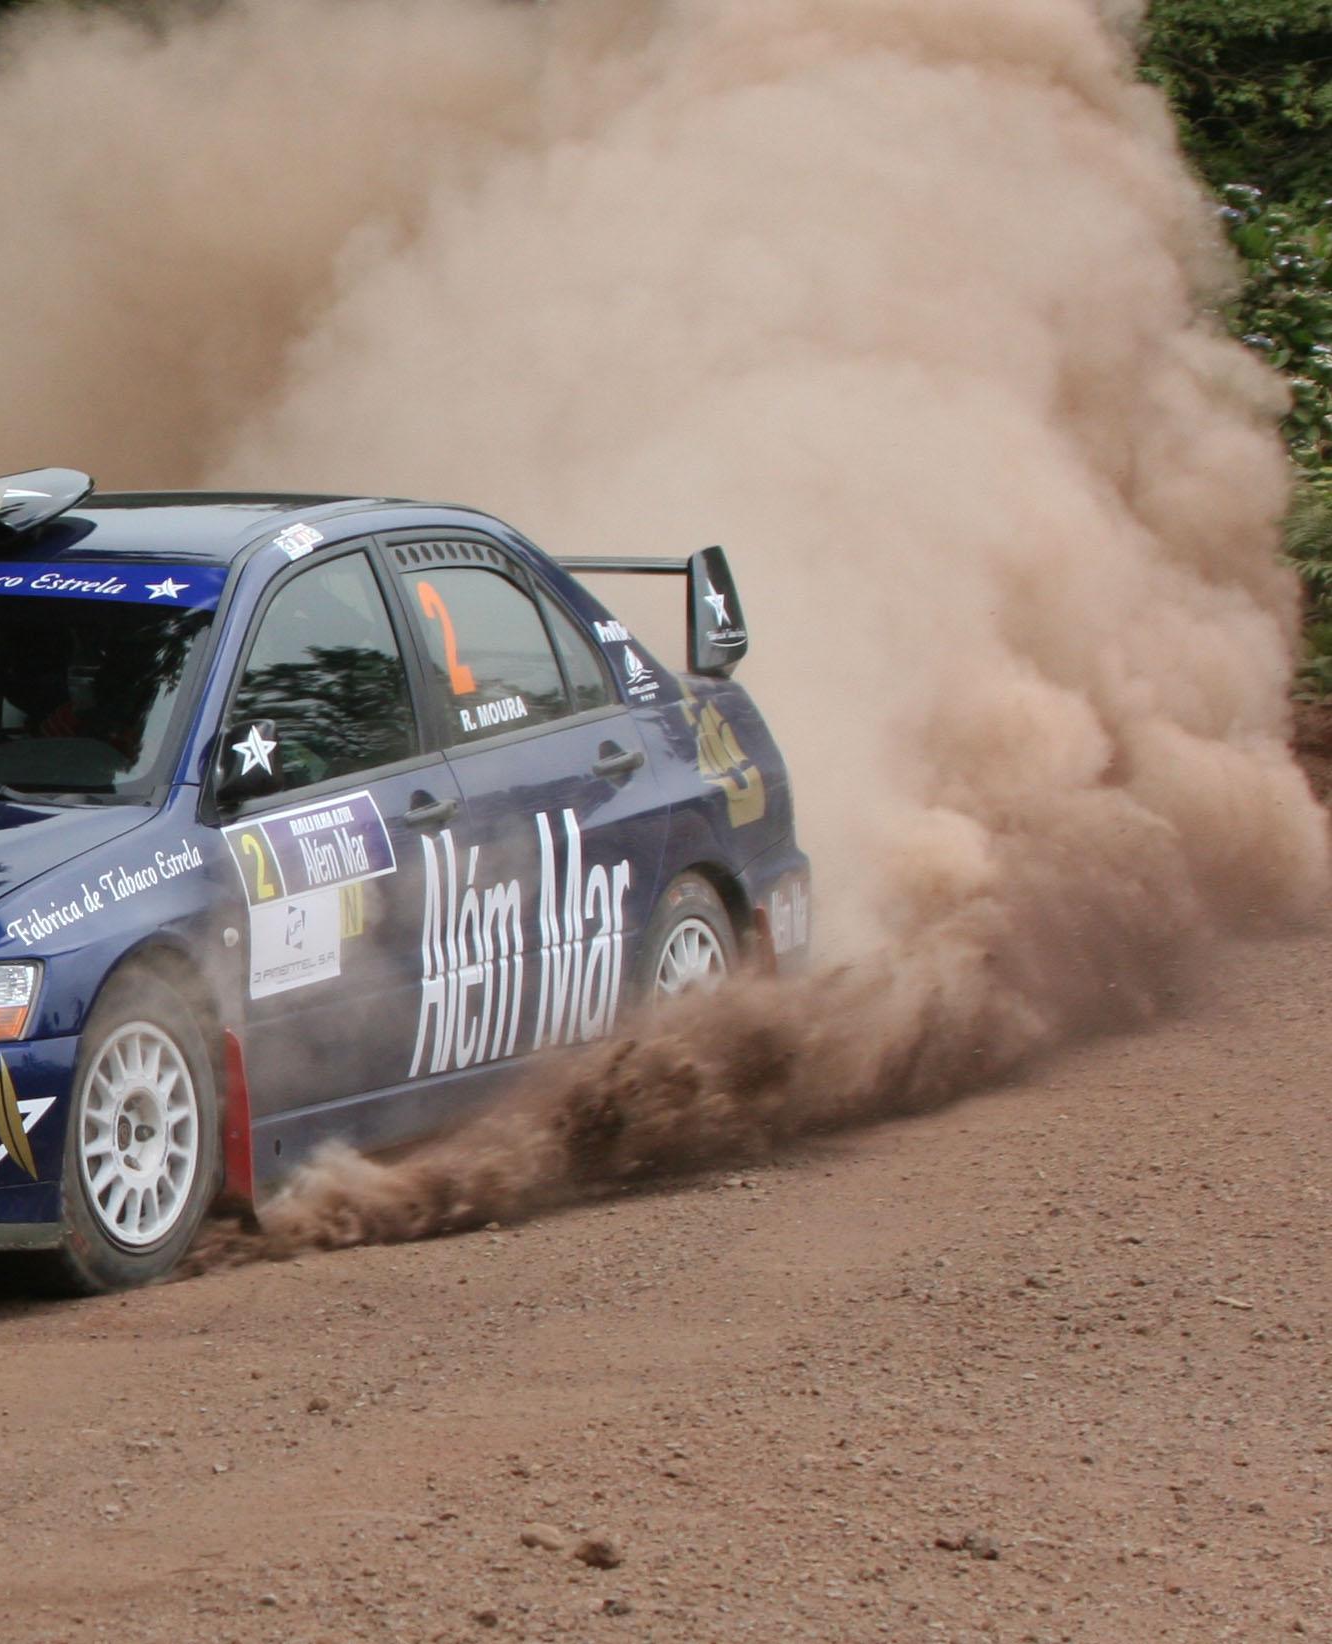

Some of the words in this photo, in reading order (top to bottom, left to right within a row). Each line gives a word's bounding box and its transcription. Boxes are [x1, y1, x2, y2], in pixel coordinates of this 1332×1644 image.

[30, 572, 129, 595] Estrela
[417, 581, 477, 695] 2
[459, 709, 477, 732] R.
[476, 695, 529, 728] MOURA
[241, 834, 275, 899] 2
[299, 836, 342, 886] Além
[333, 827, 369, 876] Mar
[6, 898, 84, 947] Fábrica
[81, 883, 104, 913] de
[99, 866, 158, 902] Tabaco
[155, 839, 203, 879] Estrela
[408, 829, 523, 1078] Além
[532, 808, 630, 1051] Mar
